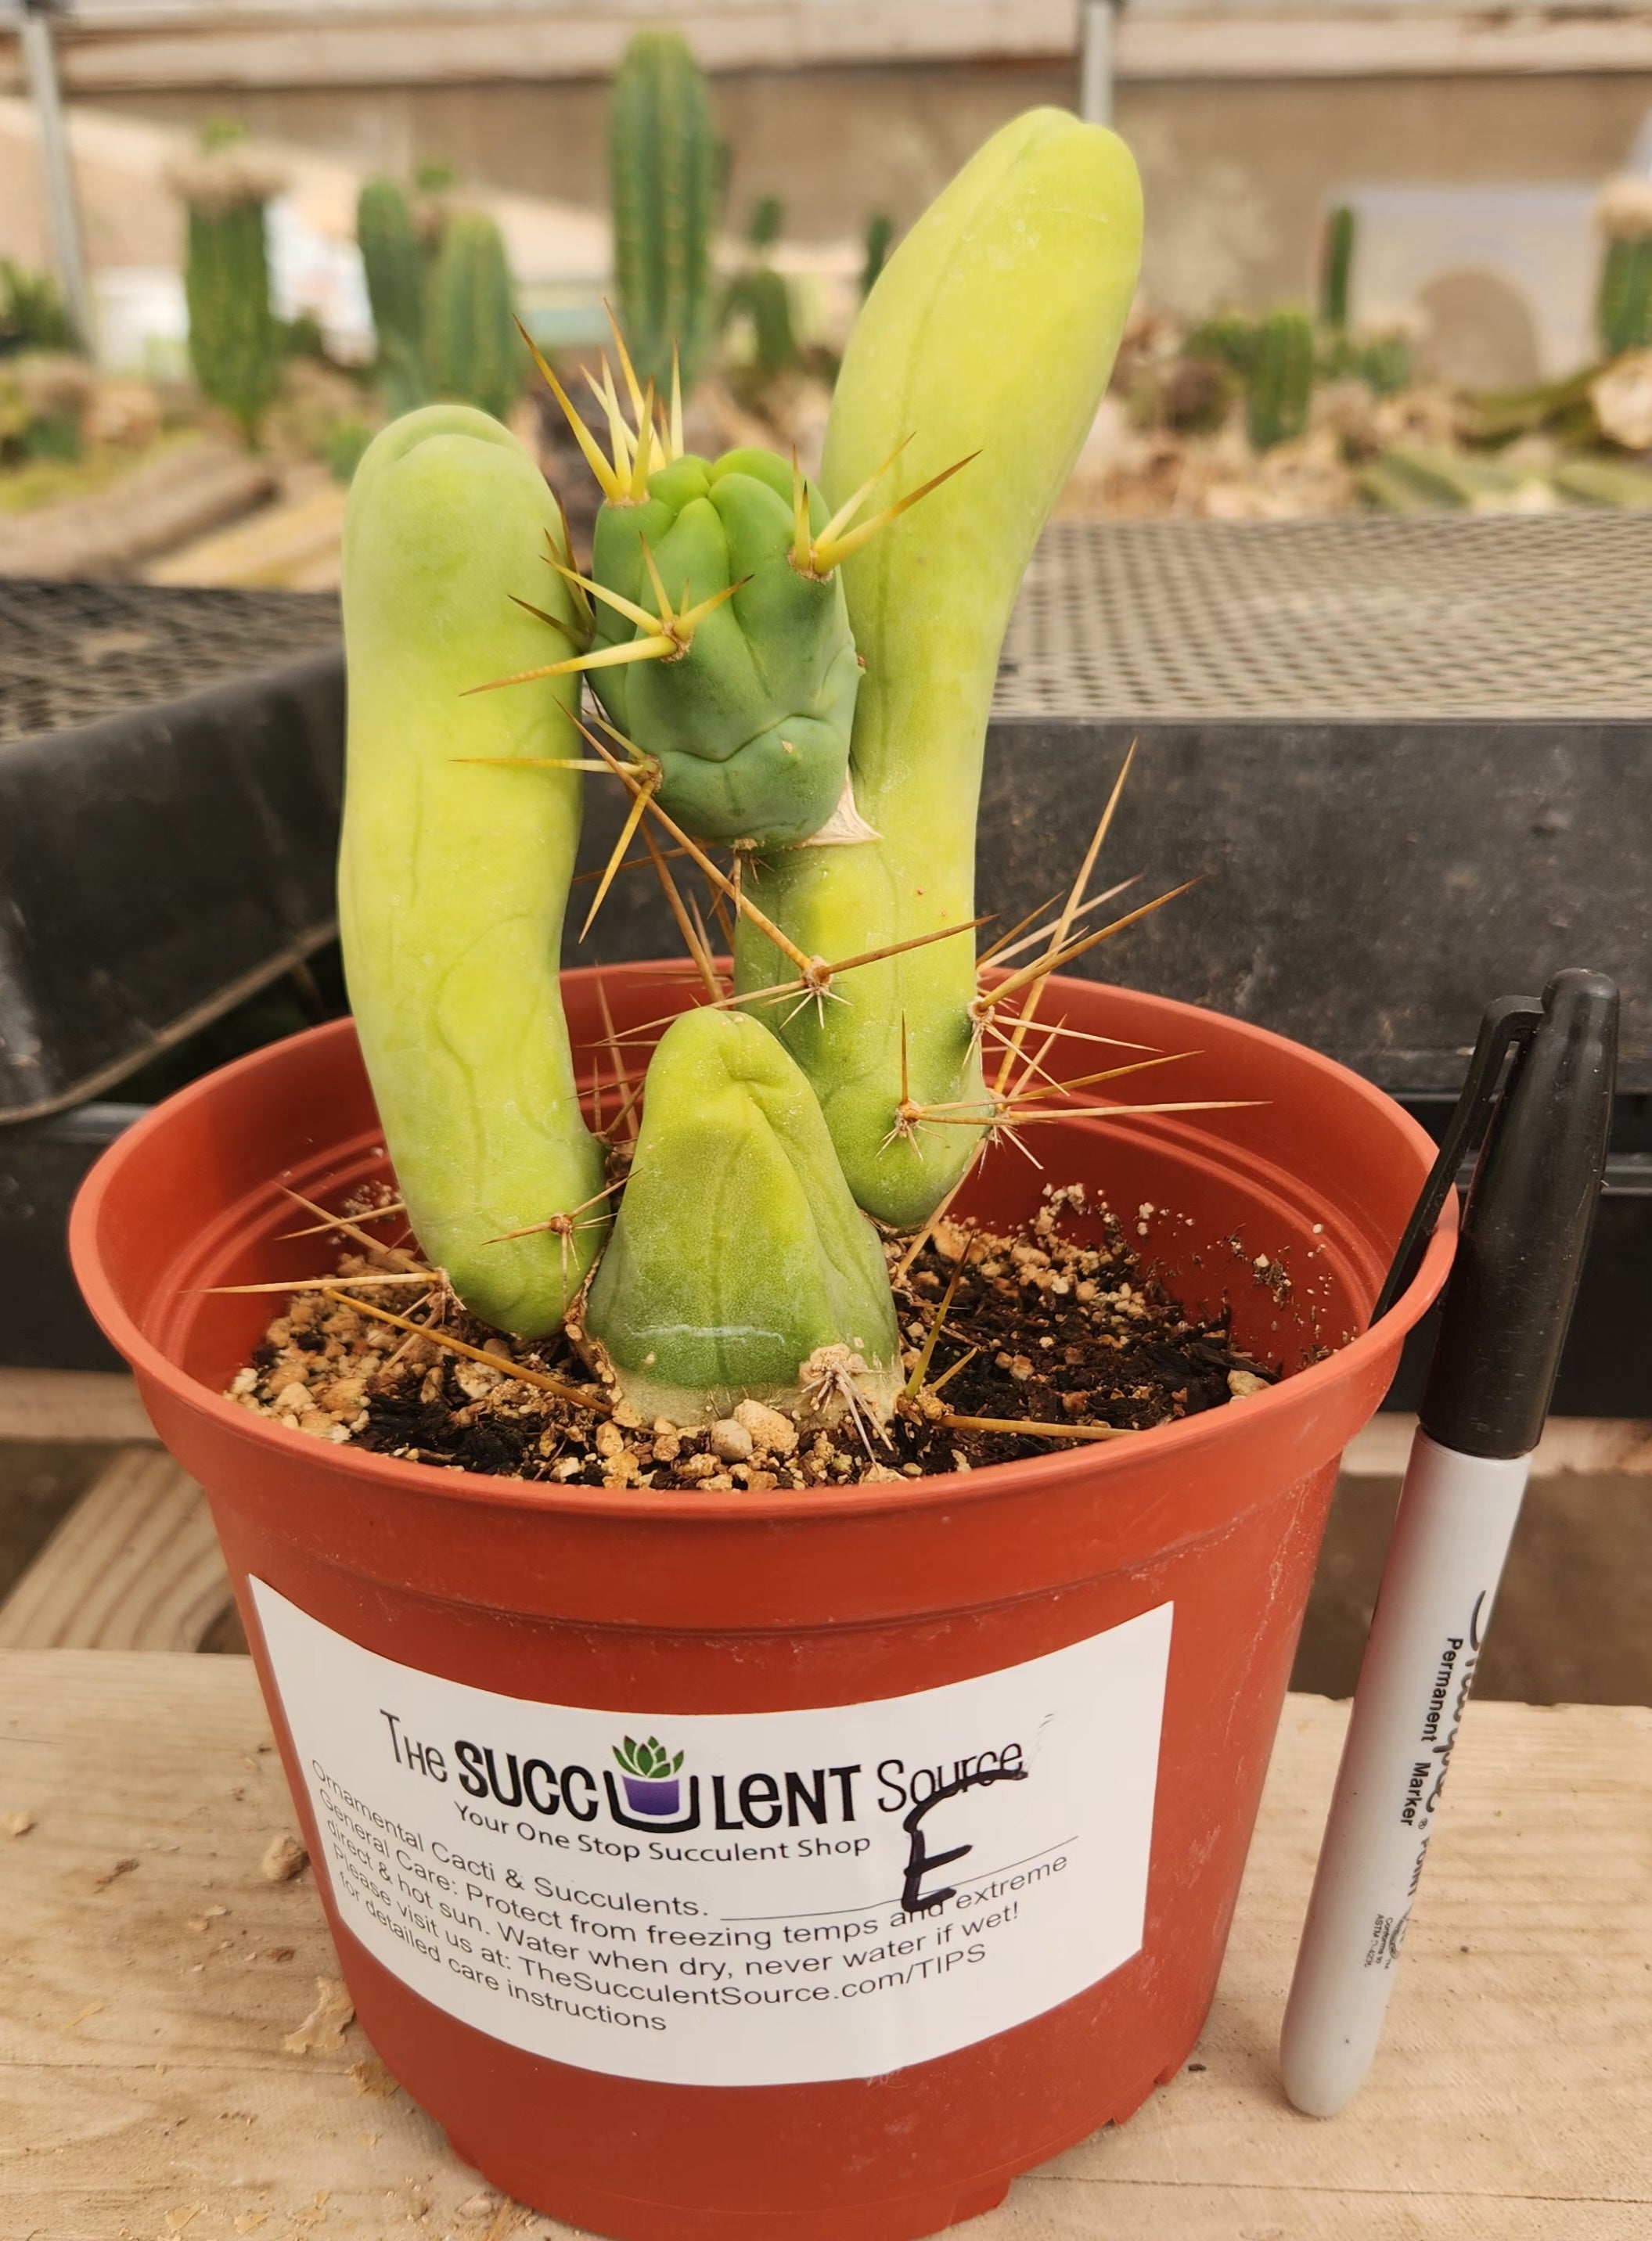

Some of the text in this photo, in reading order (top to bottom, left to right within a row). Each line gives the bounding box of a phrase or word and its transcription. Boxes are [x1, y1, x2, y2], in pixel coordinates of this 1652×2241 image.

[1420, 1638, 1463, 1742] Permanent
[312, 1759, 708, 1916] Ornamental Cacti & Succulents.
[455, 1801, 870, 1862] Your One Stop Succulent Shop
[877, 1743, 1023, 1812] Source
[1400, 1762, 1431, 1826] Marker
[319, 1787, 1067, 1951] General Care: Protect from freezing temps and extreme
[327, 1819, 1019, 1981] direct & hot sun. Water when dry, never water if wet!
[334, 1845, 986, 2005] Please visit us at: TheSucculentSource.com/TIPS
[339, 1872, 667, 2031] for detailed care instructions
